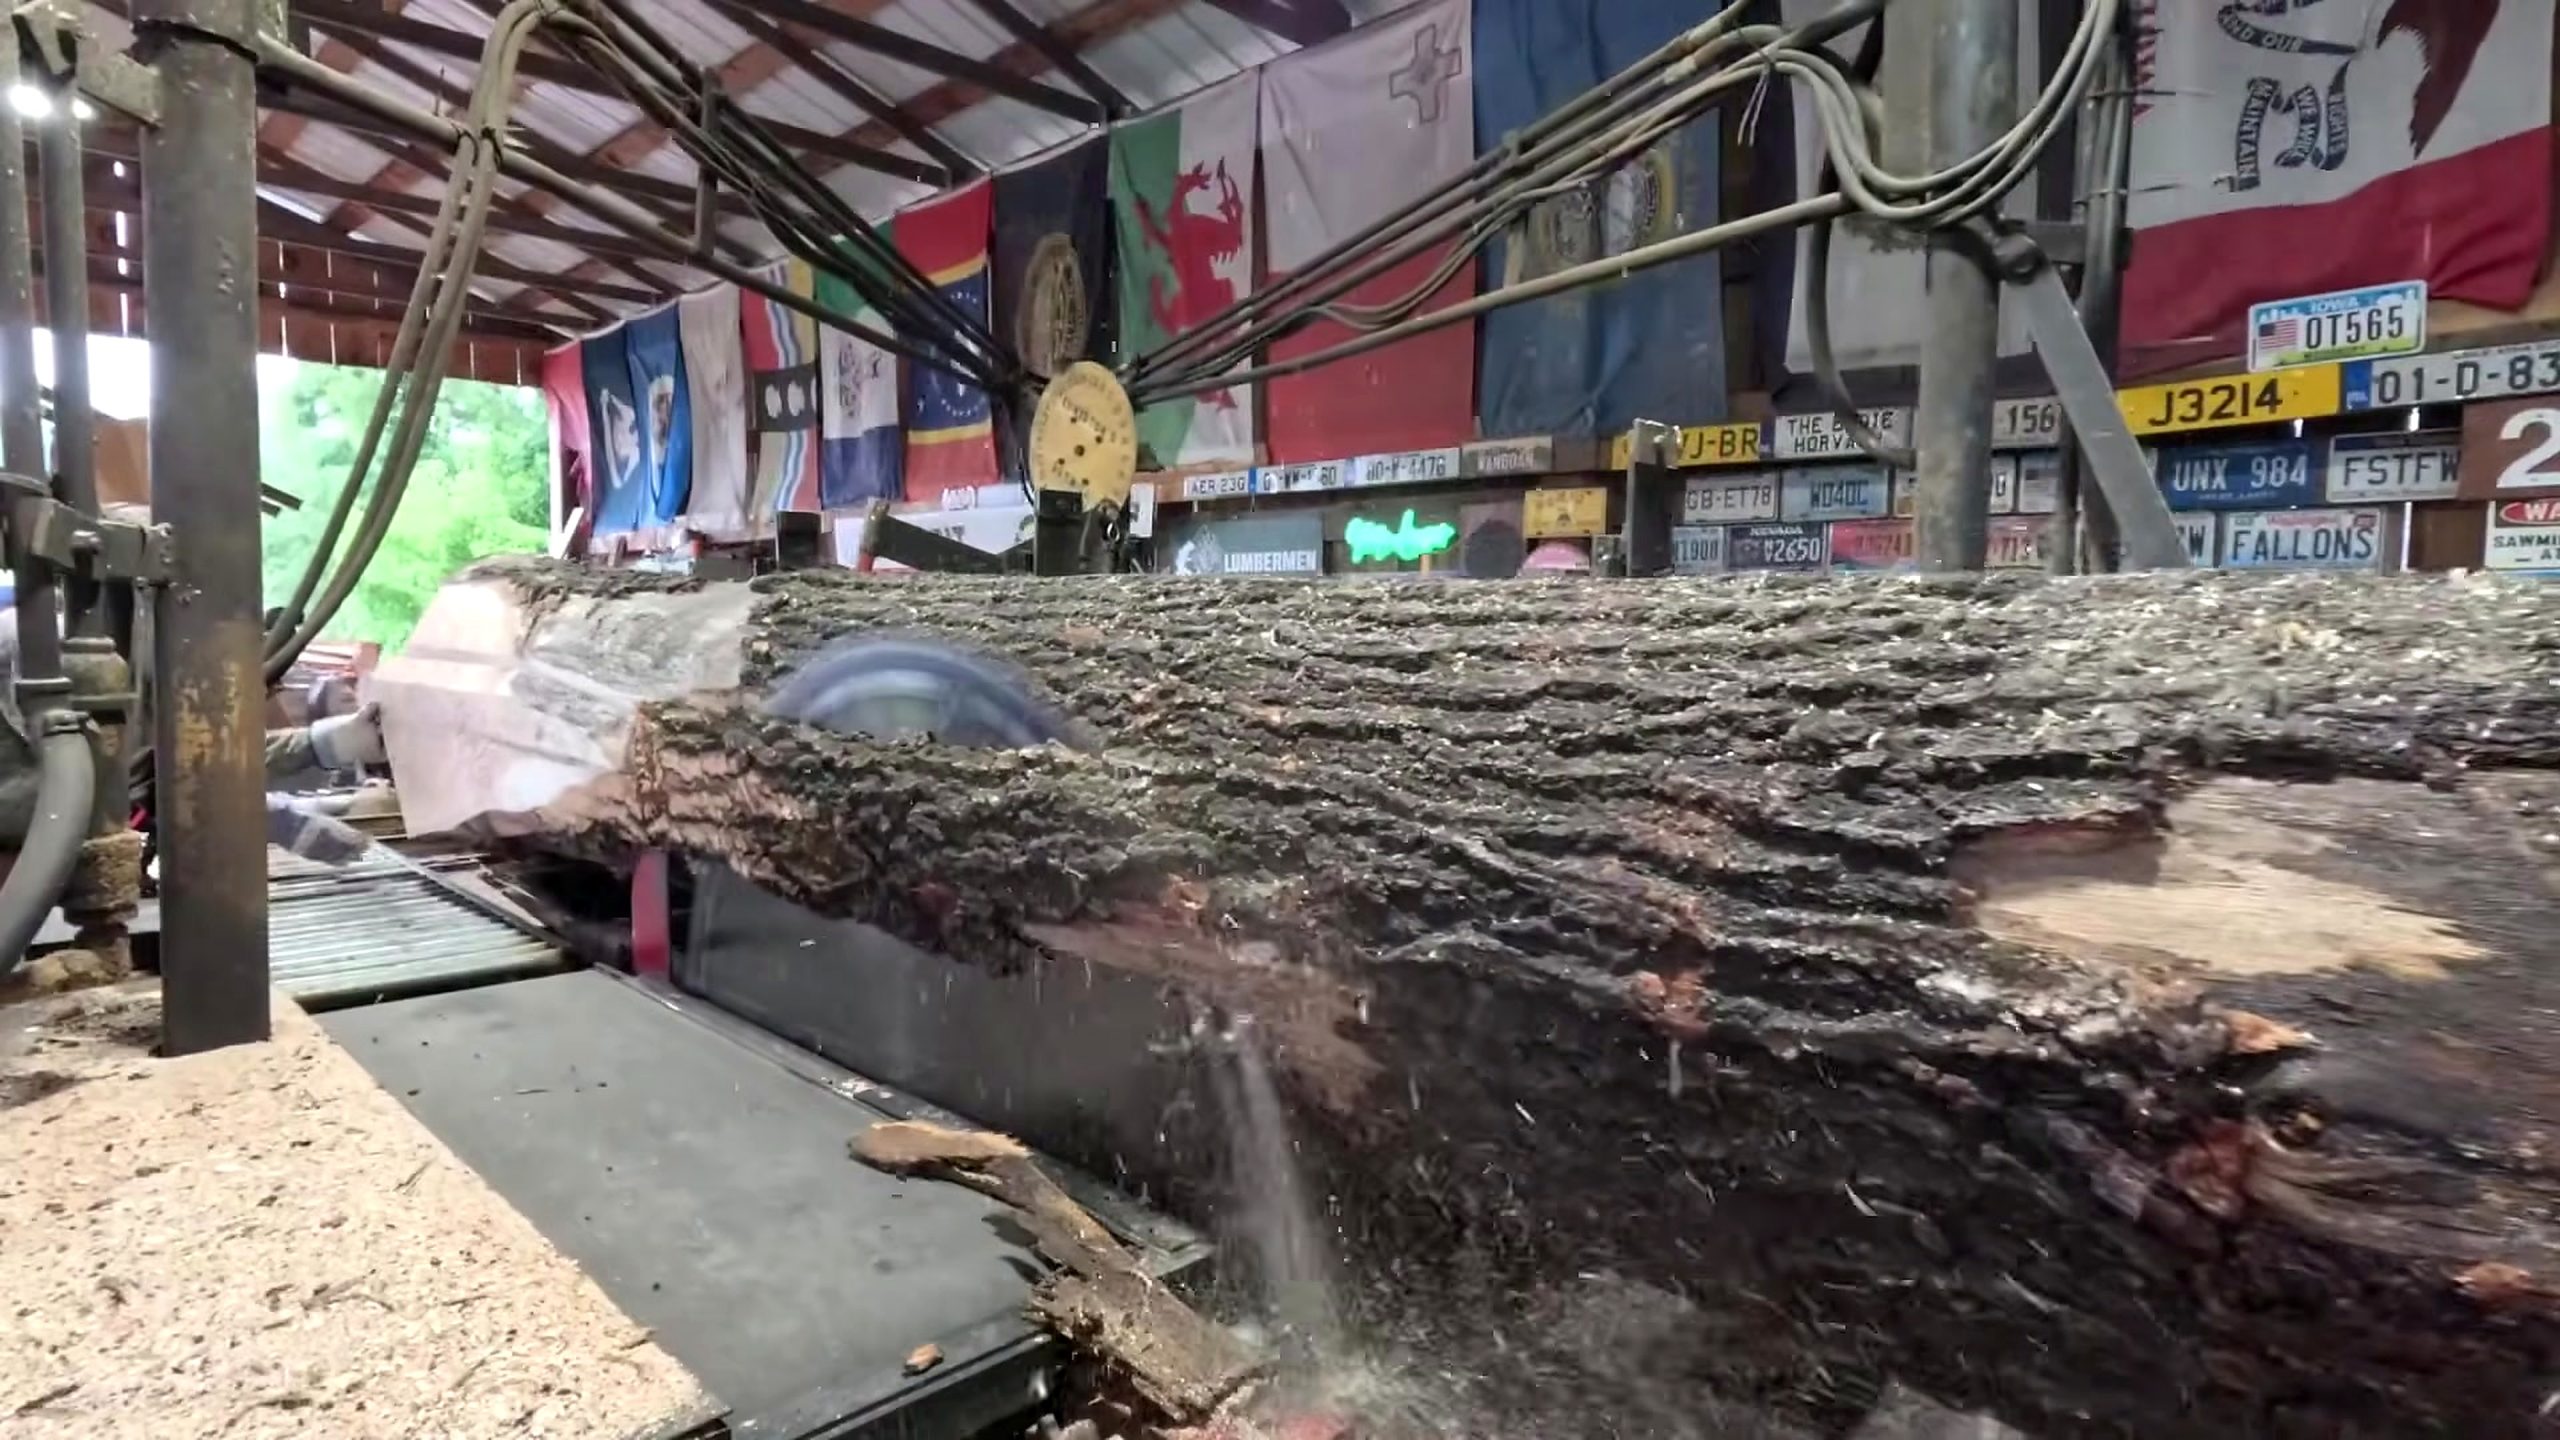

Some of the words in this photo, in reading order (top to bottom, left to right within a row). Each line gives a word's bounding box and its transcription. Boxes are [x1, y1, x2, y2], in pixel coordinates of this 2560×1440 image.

[2149, 378, 2283, 427] J3214
[1787, 417, 1823, 435] THE
[2496, 408, 2560, 489] 2
[2173, 456, 2229, 492] UNX
[2250, 455, 2308, 488] 984
[2232, 528, 2374, 562] FALLONS
[2494, 532, 2560, 548] SAWMI
[1223, 549, 1317, 572] LUMBERMEN
